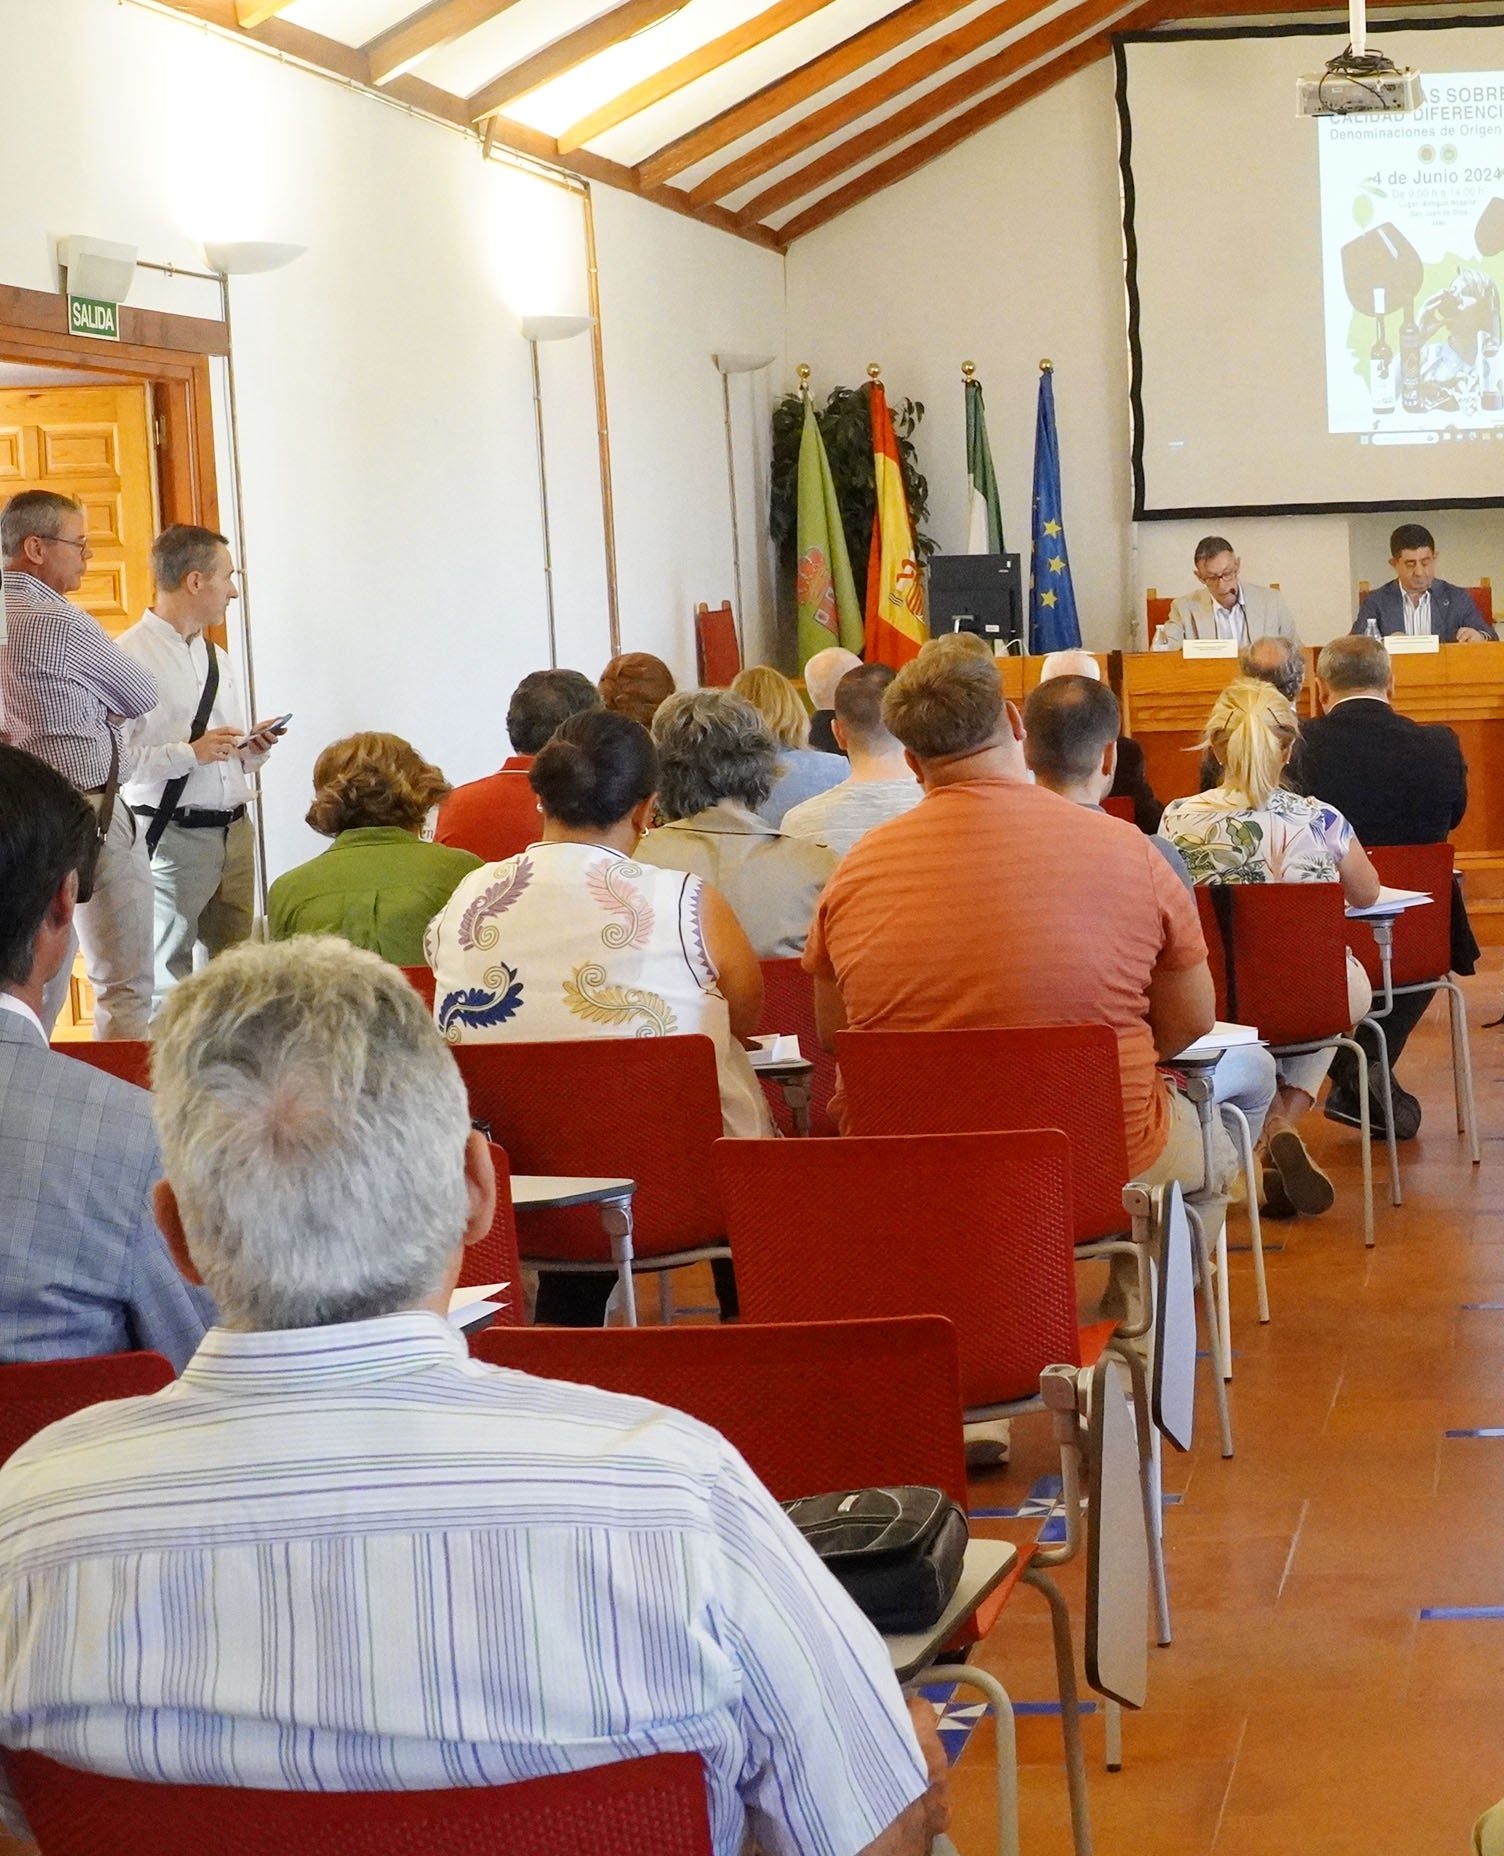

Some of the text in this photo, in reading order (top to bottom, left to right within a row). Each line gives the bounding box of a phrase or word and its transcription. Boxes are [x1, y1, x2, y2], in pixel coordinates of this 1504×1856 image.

[1330, 127, 1436, 140] Denominaciones
[1440, 124, 1455, 137] de
[1460, 123, 1502, 138] Origen
[1388, 170, 1407, 185] de
[1413, 168, 1459, 185] Junio
[1464, 167, 1502, 183] 2024
[73, 302, 115, 331] SALIDA
